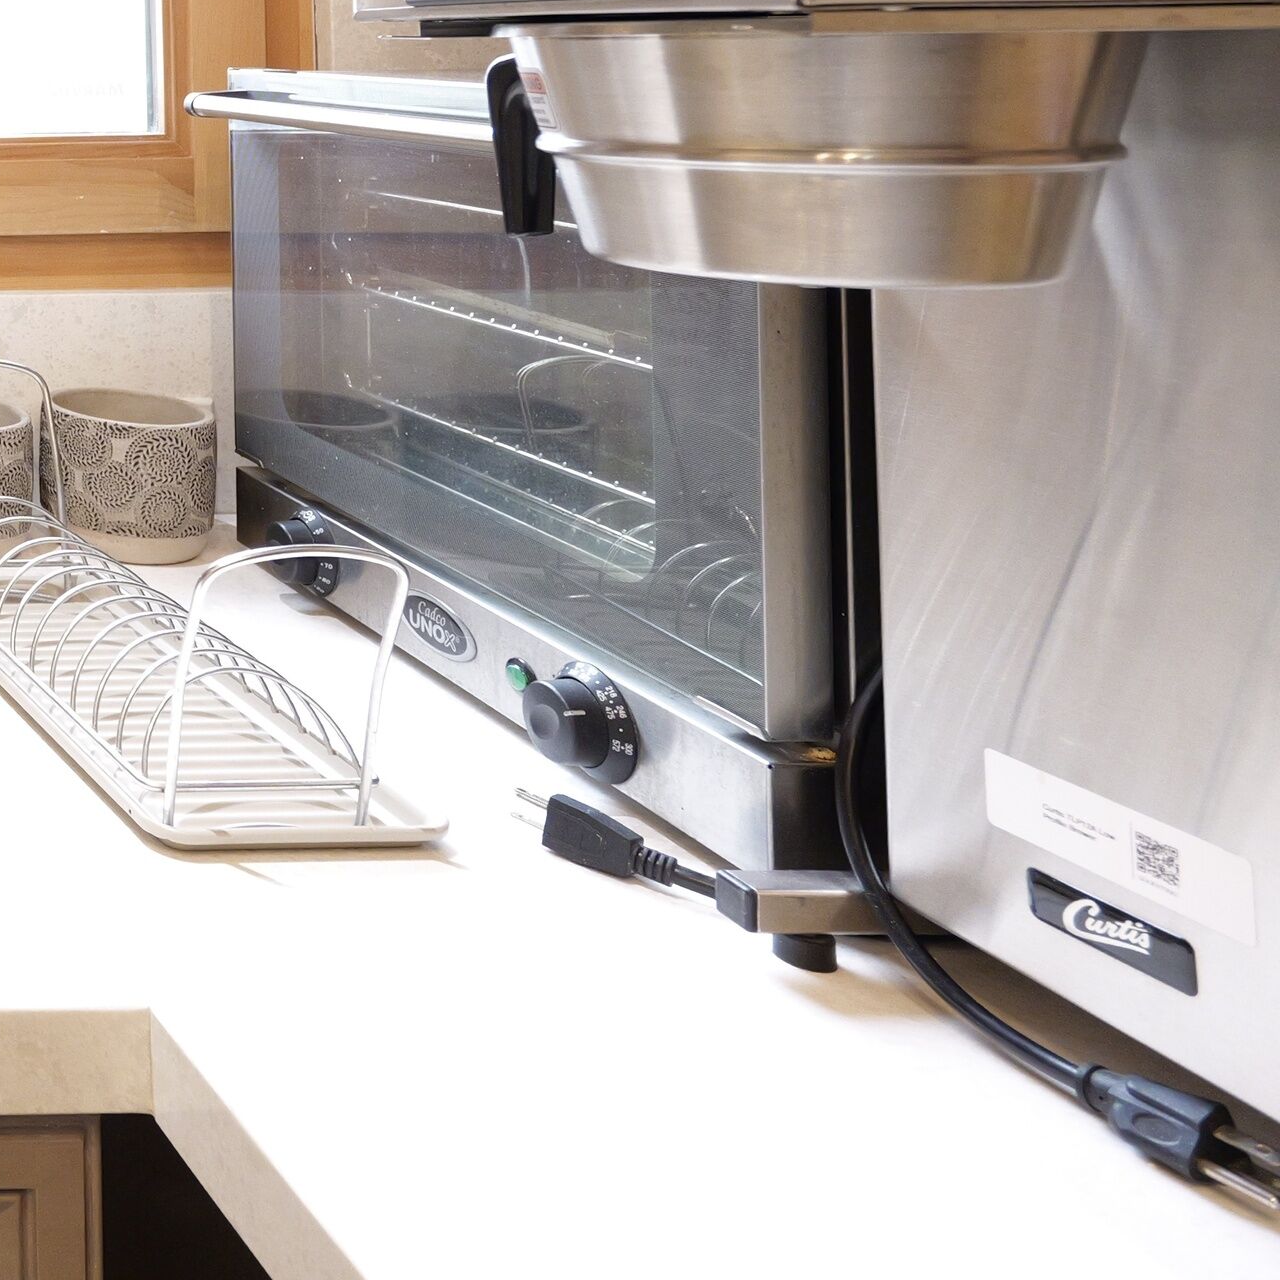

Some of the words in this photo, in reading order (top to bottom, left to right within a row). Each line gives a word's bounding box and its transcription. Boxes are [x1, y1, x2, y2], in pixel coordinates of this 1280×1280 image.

[409, 608, 456, 652] UNOX
[418, 601, 446, 627] Cadco
[605, 706, 616, 720] 475
[1062, 898, 1151, 955] Curtis
